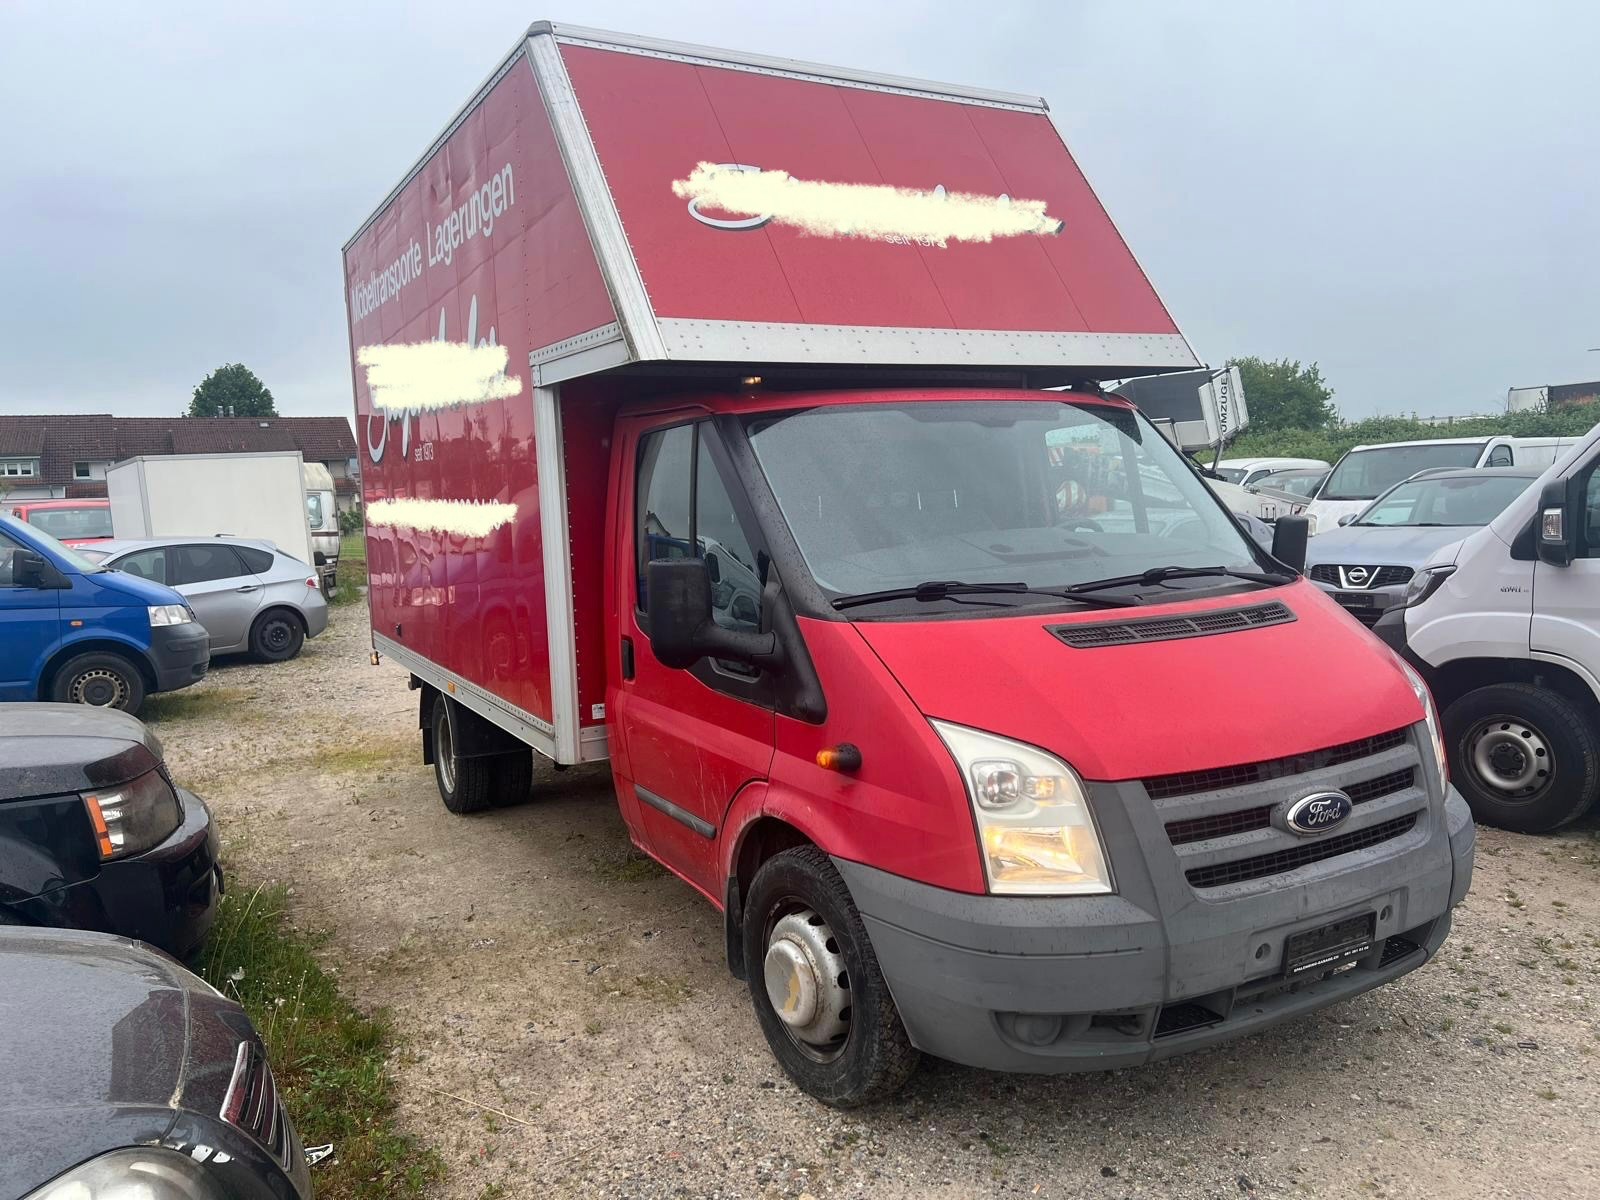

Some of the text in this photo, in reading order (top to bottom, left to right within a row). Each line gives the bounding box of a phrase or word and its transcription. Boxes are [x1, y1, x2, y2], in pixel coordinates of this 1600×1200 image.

[352, 163, 514, 324] Möbeltransporte Lagerungen
[423, 442, 433, 460] 1973
[1308, 800, 1341, 825] Ford
